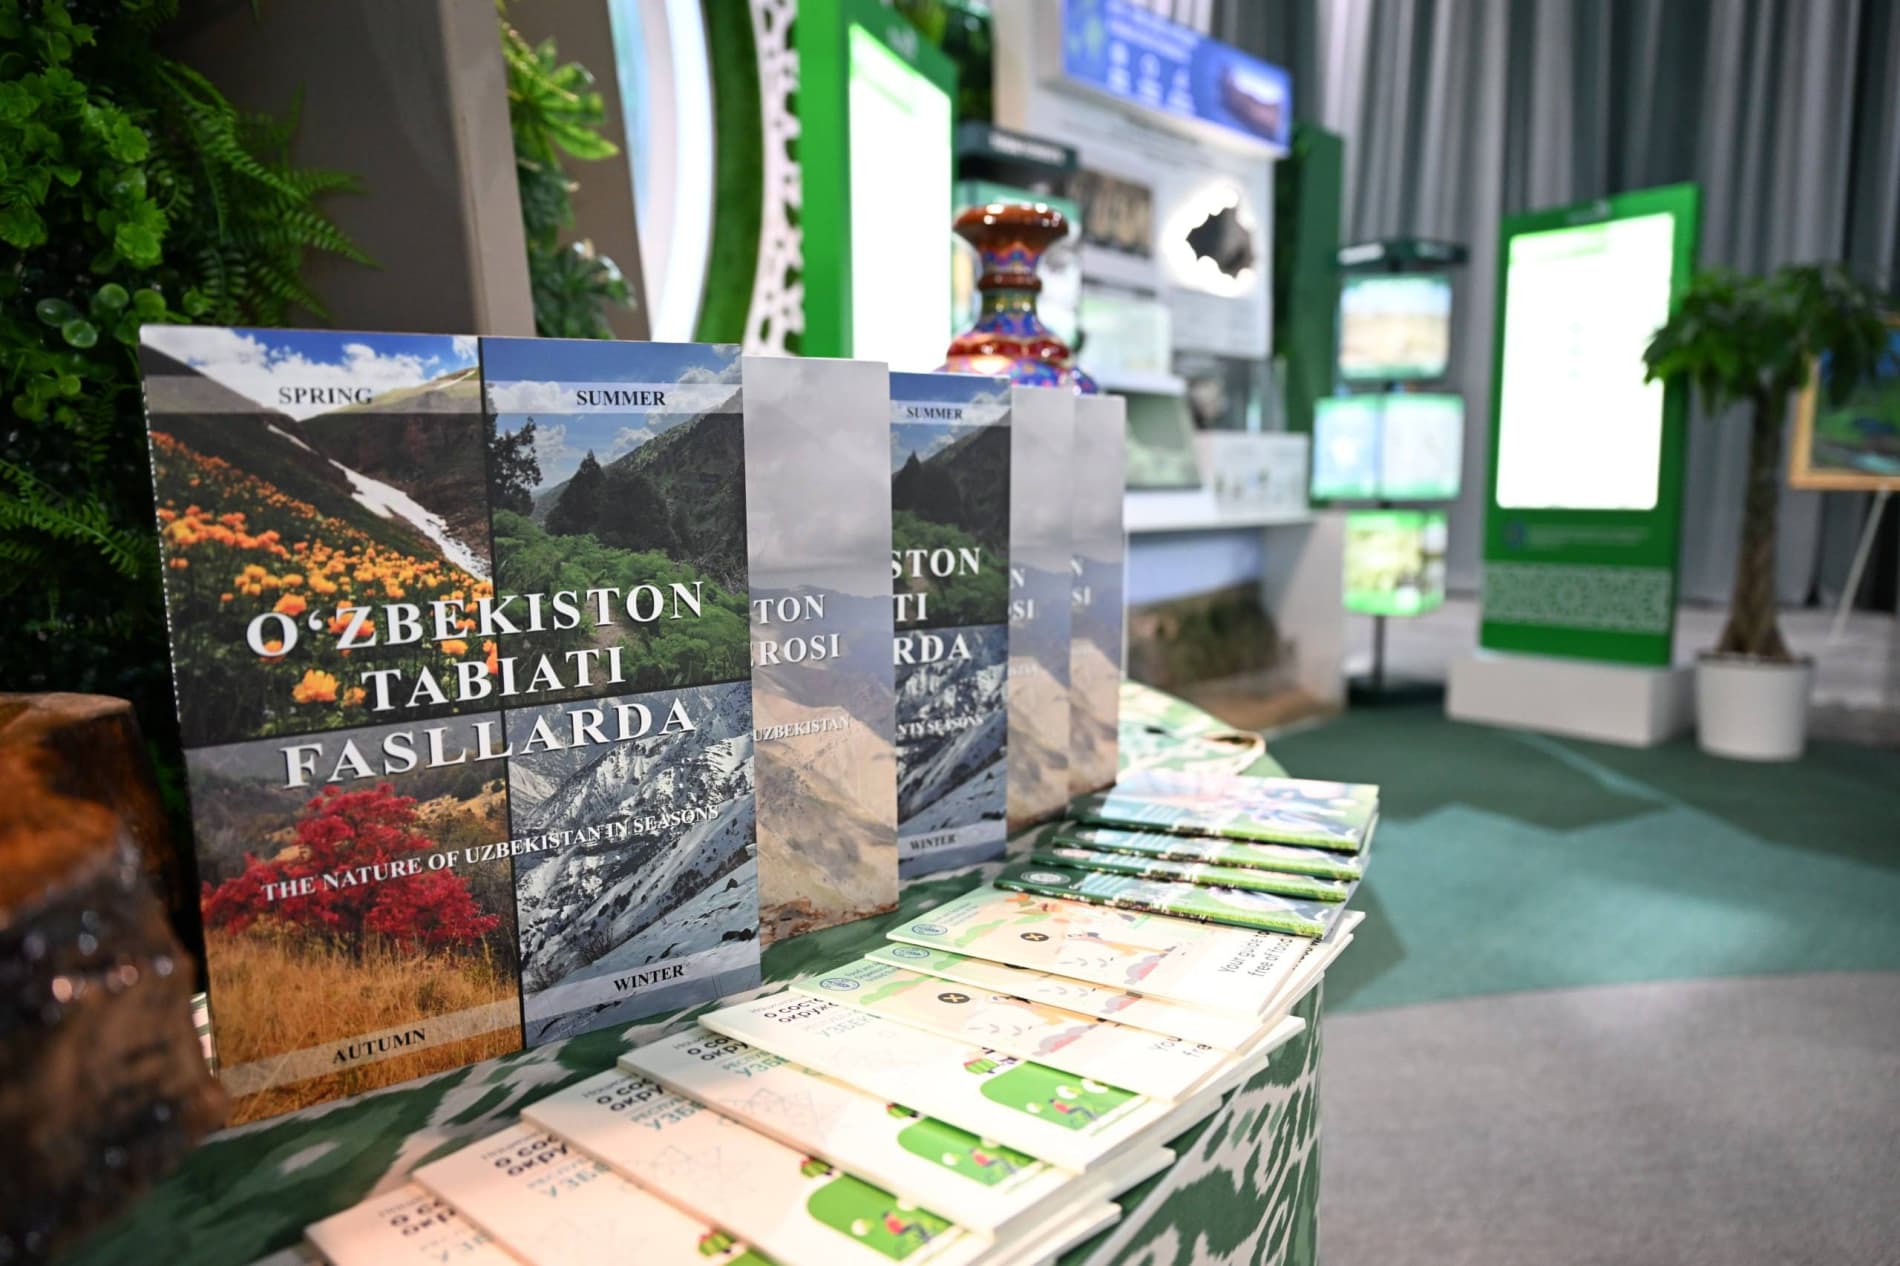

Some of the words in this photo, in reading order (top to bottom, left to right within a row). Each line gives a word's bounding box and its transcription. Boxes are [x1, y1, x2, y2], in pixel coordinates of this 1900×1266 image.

[278, 387, 373, 405] SPRING
[576, 390, 666, 406] SUMMER
[906, 407, 963, 420] SUMMER
[361, 646, 625, 712] TABIATI
[753, 715, 851, 742] UZBEKISTAN
[280, 697, 697, 789] FASLLARDA
[261, 876, 316, 901] THE
[322, 857, 423, 892] NATURE
[428, 851, 460, 871] OF
[465, 825, 601, 864] UZBEKISTAN
[606, 822, 628, 839] IN
[633, 804, 719, 834] SEASONS
[909, 834, 956, 850] WINTER
[614, 964, 684, 992] WINTER
[332, 1027, 426, 1064] AUTUMN
